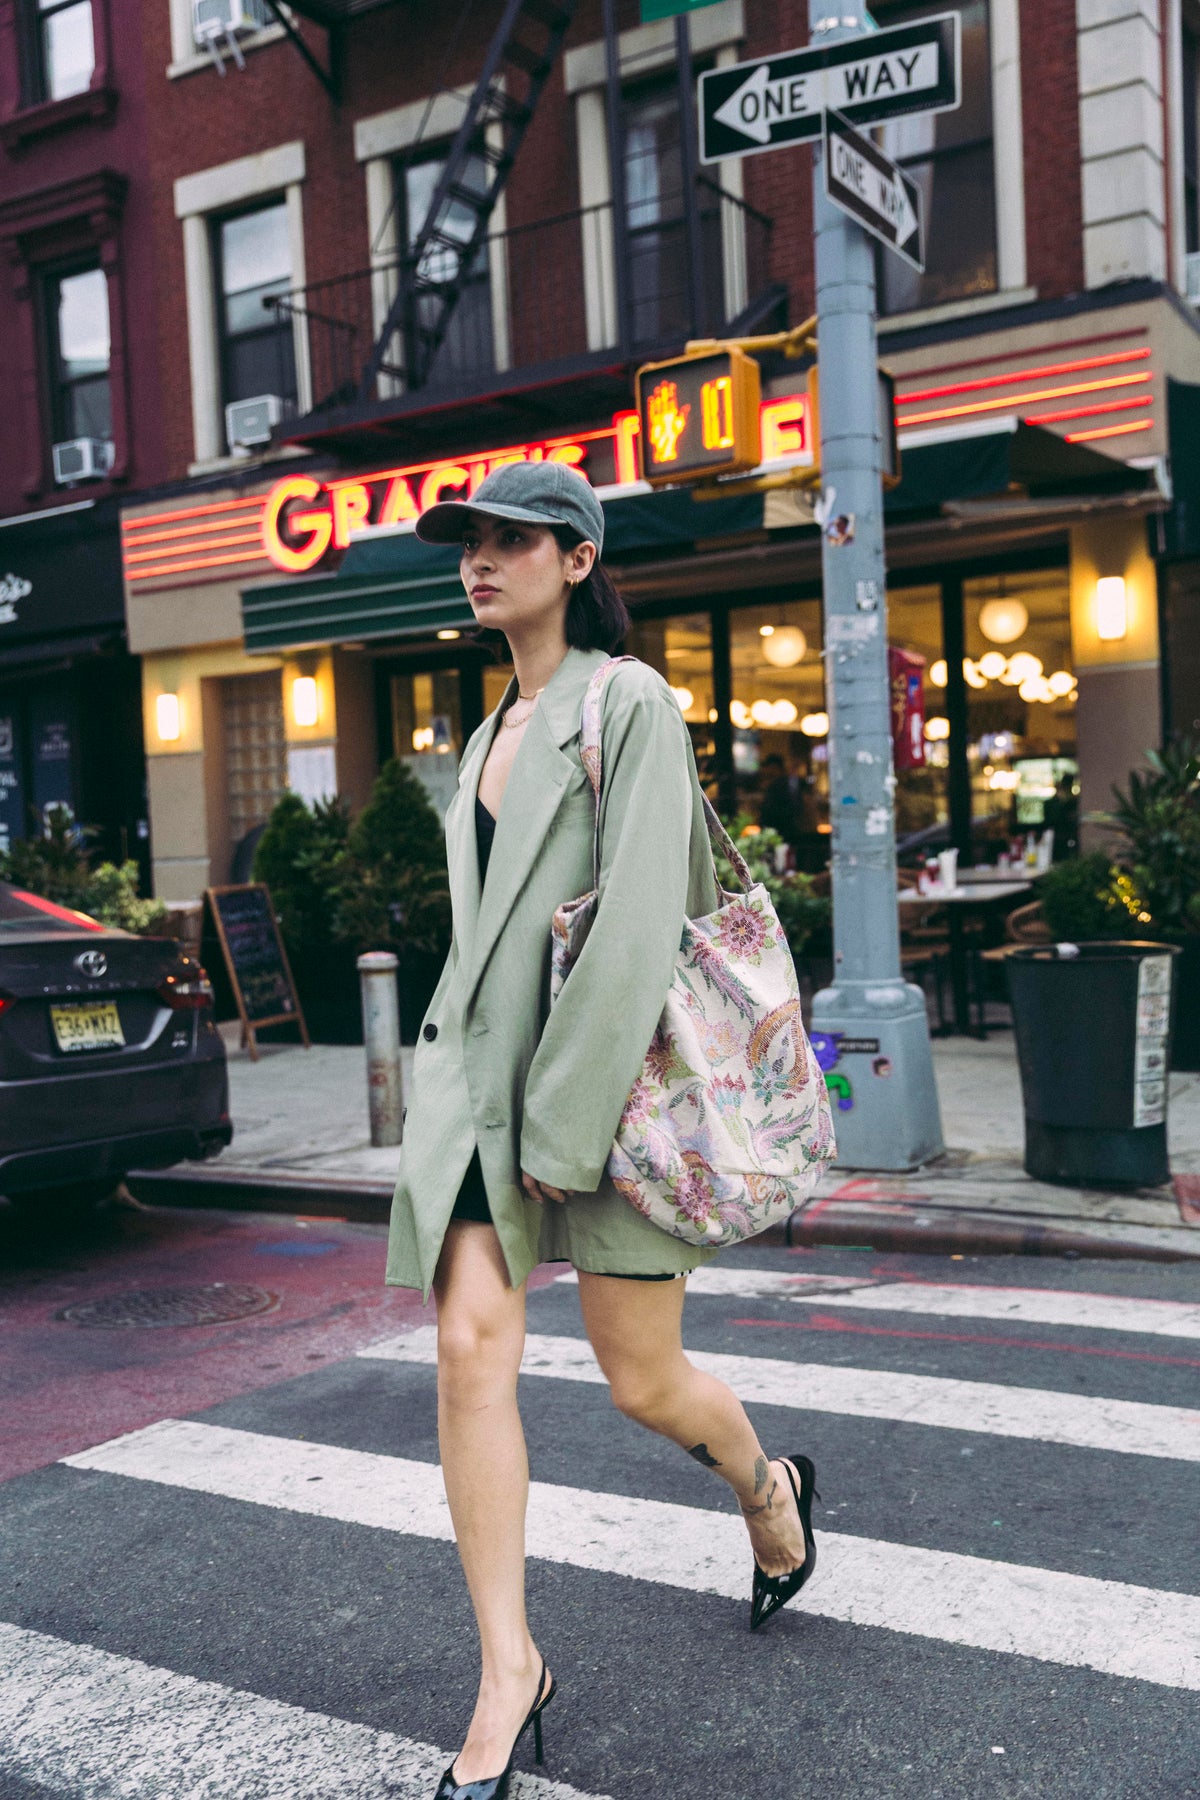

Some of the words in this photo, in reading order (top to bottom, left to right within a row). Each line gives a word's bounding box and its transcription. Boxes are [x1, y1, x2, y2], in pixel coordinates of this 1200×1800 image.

[740, 80, 807, 123] ONE
[843, 52, 920, 99] WAY
[836, 145, 865, 195] ONE
